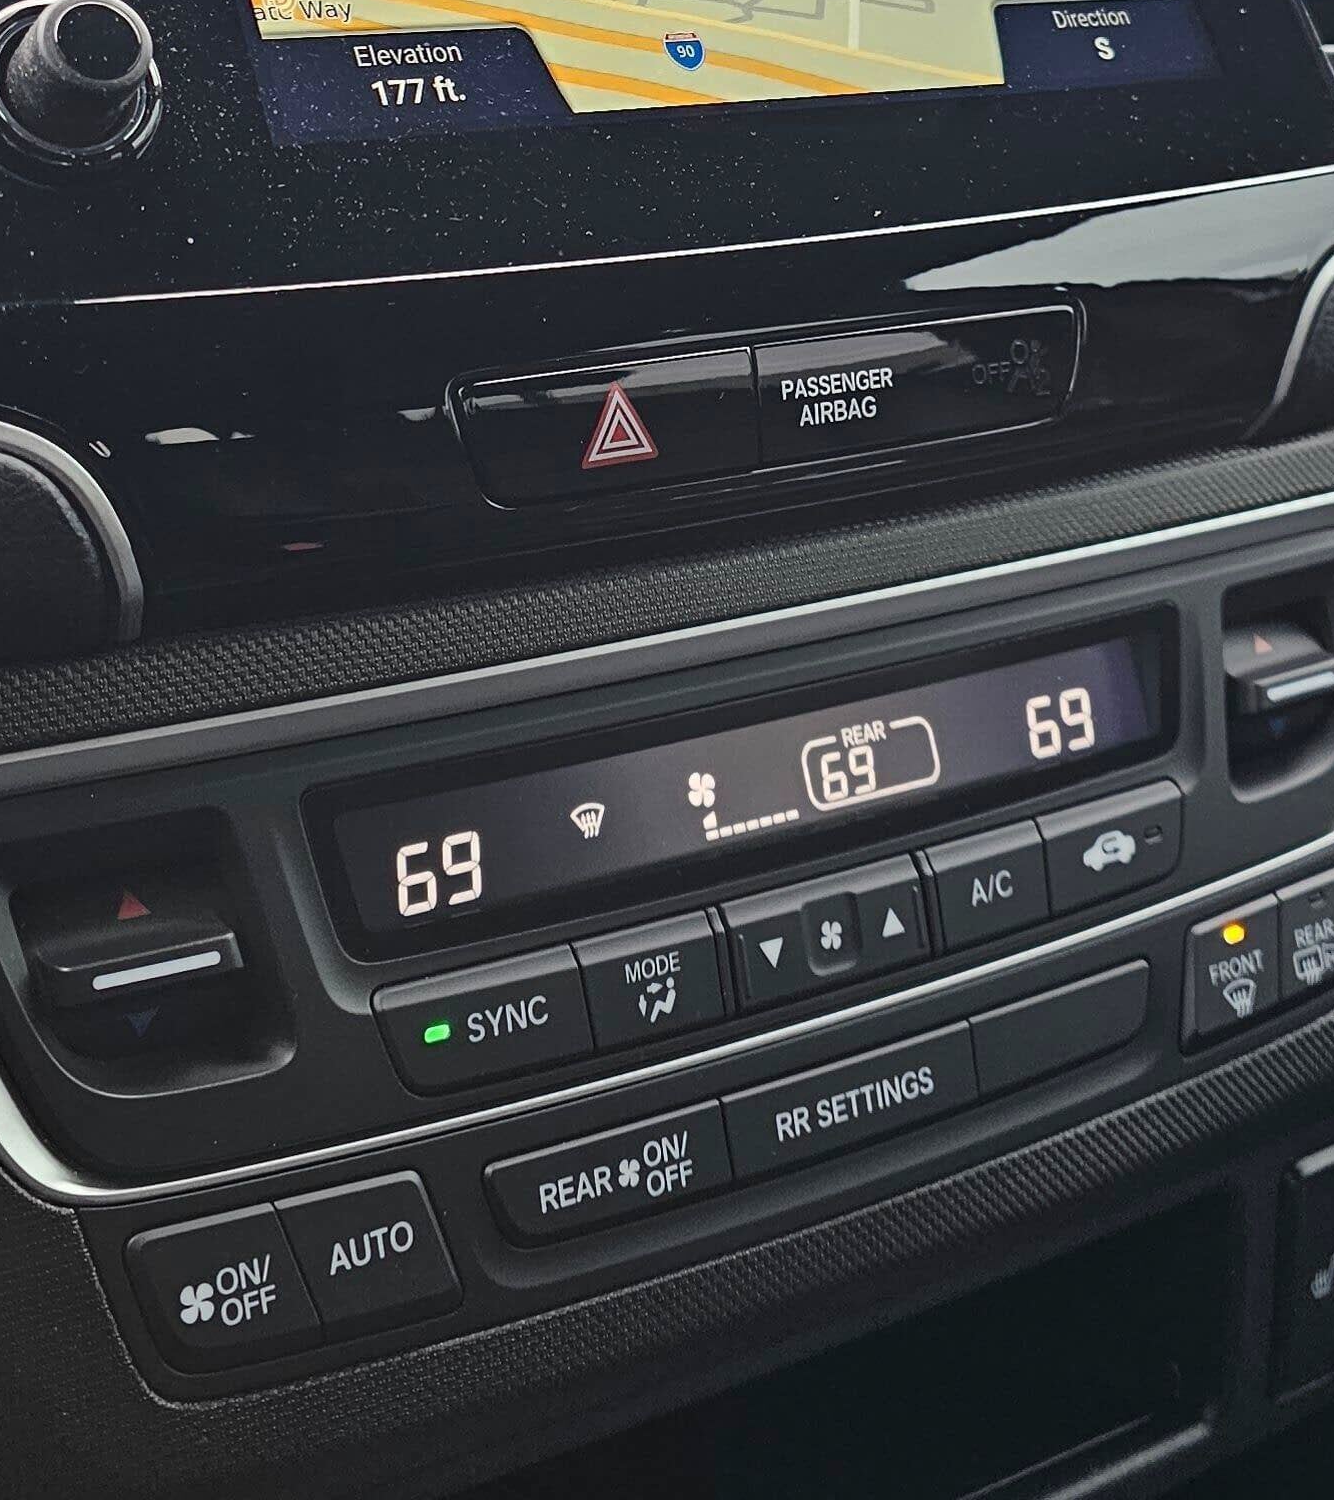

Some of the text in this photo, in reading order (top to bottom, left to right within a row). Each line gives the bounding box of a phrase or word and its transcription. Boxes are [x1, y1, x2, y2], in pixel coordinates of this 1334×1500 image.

[299, 0, 351, 22] Way
[1051, 8, 1131, 29] Direction
[353, 44, 463, 67] Elevation
[677, 45, 695, 58] 90
[1094, 36, 1116, 60] S
[371, 75, 467, 106] 177 ft.
[781, 367, 893, 400] PASSENGER
[799, 396, 877, 427] AIRBAG
[841, 720, 887, 749] REAR
[1025, 687, 1096, 760] 69
[820, 746, 878, 802] 69
[396, 830, 483, 918] 69
[971, 869, 1014, 907] A/C
[624, 951, 681, 984] MODE
[1208, 949, 1264, 986] FRONT
[467, 995, 550, 1043] SYNC
[775, 1065, 935, 1143] RR SETTINGS
[642, 1130, 689, 1168] ON/
[538, 1165, 613, 1215] REAR
[646, 1159, 694, 1198] OFF
[329, 1221, 415, 1276] AUTO
[216, 1253, 271, 1295] ON/
[220, 1284, 276, 1327] OFF
